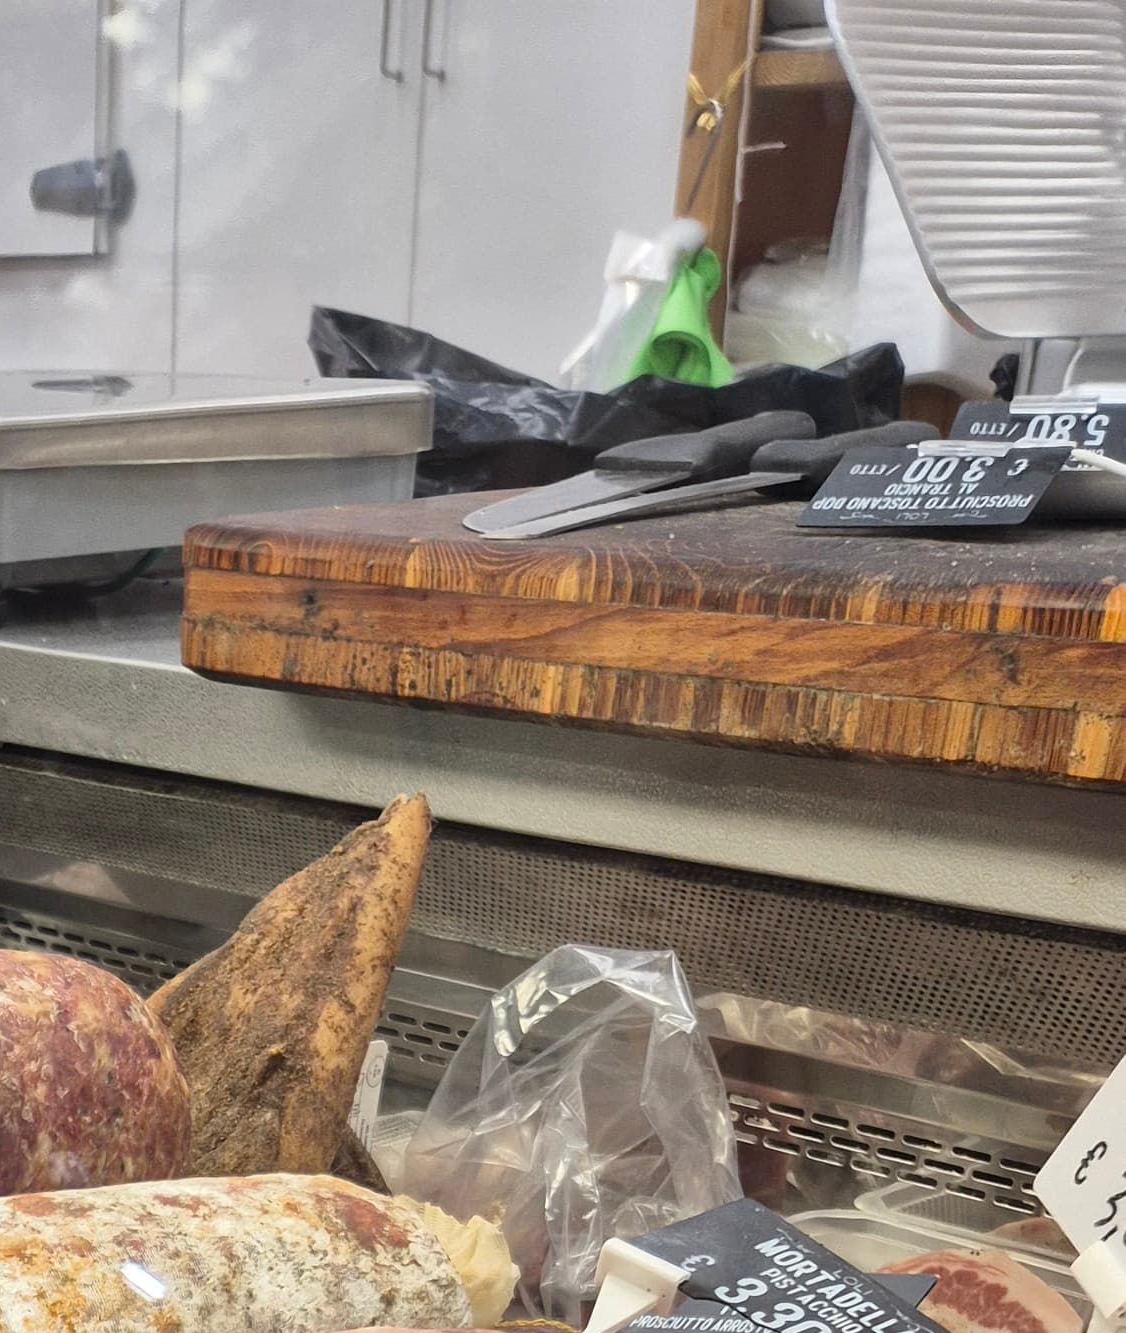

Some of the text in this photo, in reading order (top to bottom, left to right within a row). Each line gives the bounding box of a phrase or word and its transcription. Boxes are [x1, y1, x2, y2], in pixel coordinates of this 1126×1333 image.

[1025, 414, 1109, 446] 5.80
[902, 456, 994, 483] 3.00
[1007, 458, 1029, 476] €
[884, 482, 979, 496] AL TRANCIO
[812, 494, 1034, 510] PROSCIUTTO TOSCANO DOP
[832, 1269, 873, 1295] LOLI
[629, 1315, 714, 1331] PROSCIUTTO
